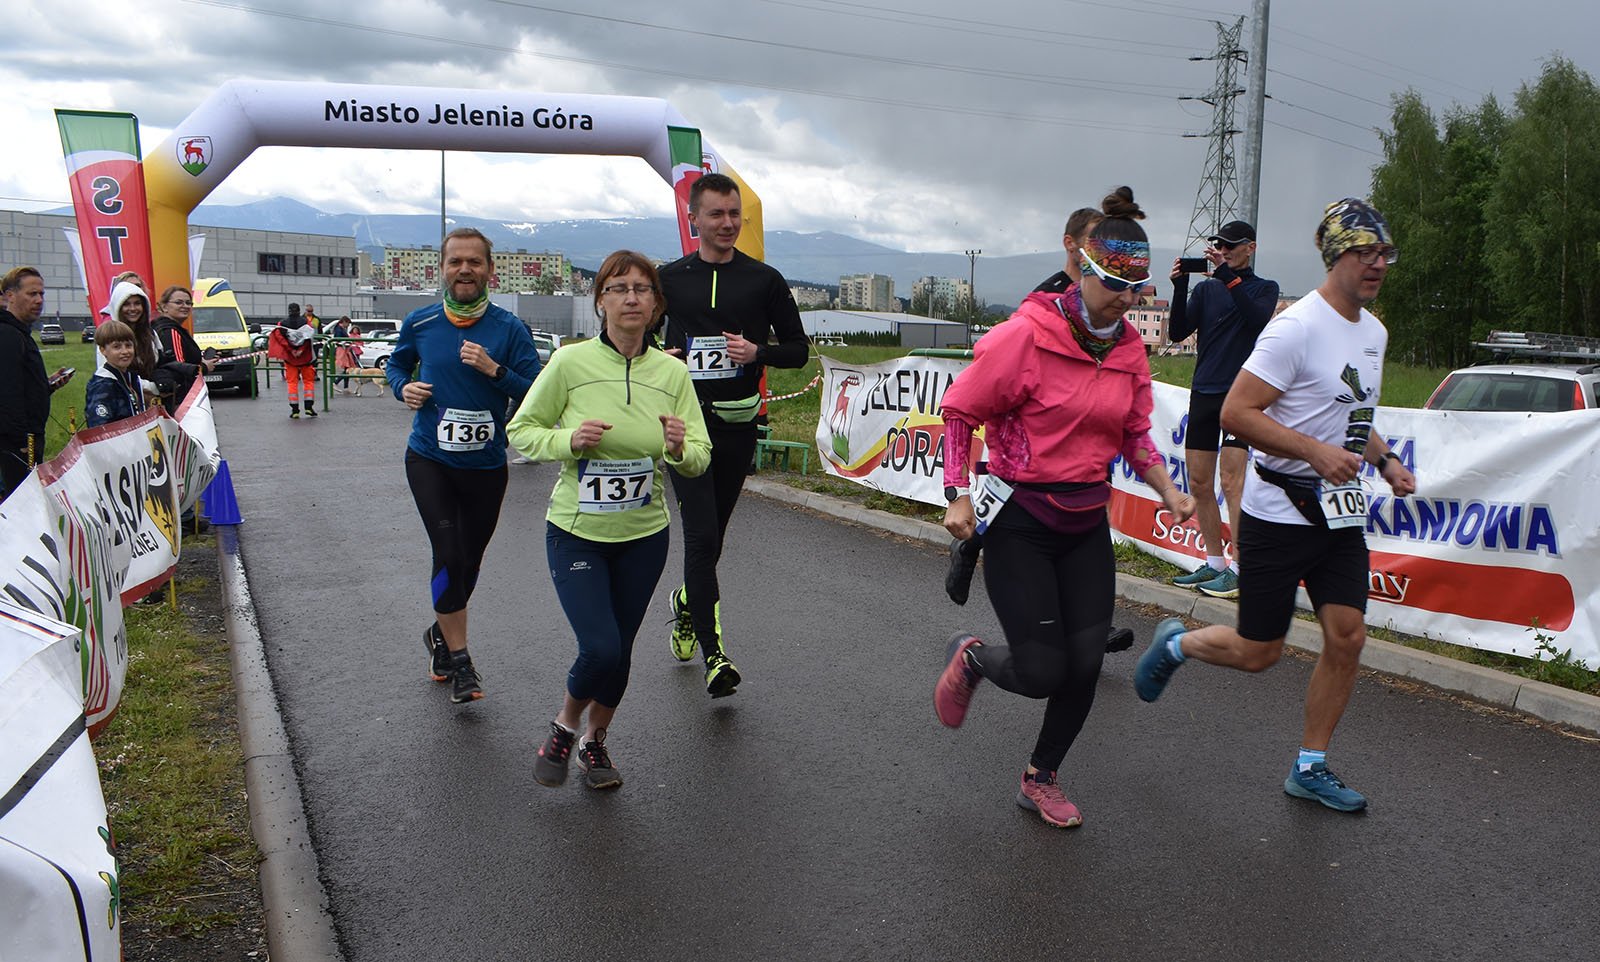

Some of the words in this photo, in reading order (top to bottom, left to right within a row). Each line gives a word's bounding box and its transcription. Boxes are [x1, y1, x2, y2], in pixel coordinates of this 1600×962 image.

[324, 100, 420, 123] Miasto
[427, 104, 524, 127] Jelenia
[532, 107, 593, 130] Góra
[443, 422, 490, 443] 136
[587, 475, 647, 501] 137
[1327, 491, 1366, 515] 109
[1365, 494, 1559, 556] KANIOWA
